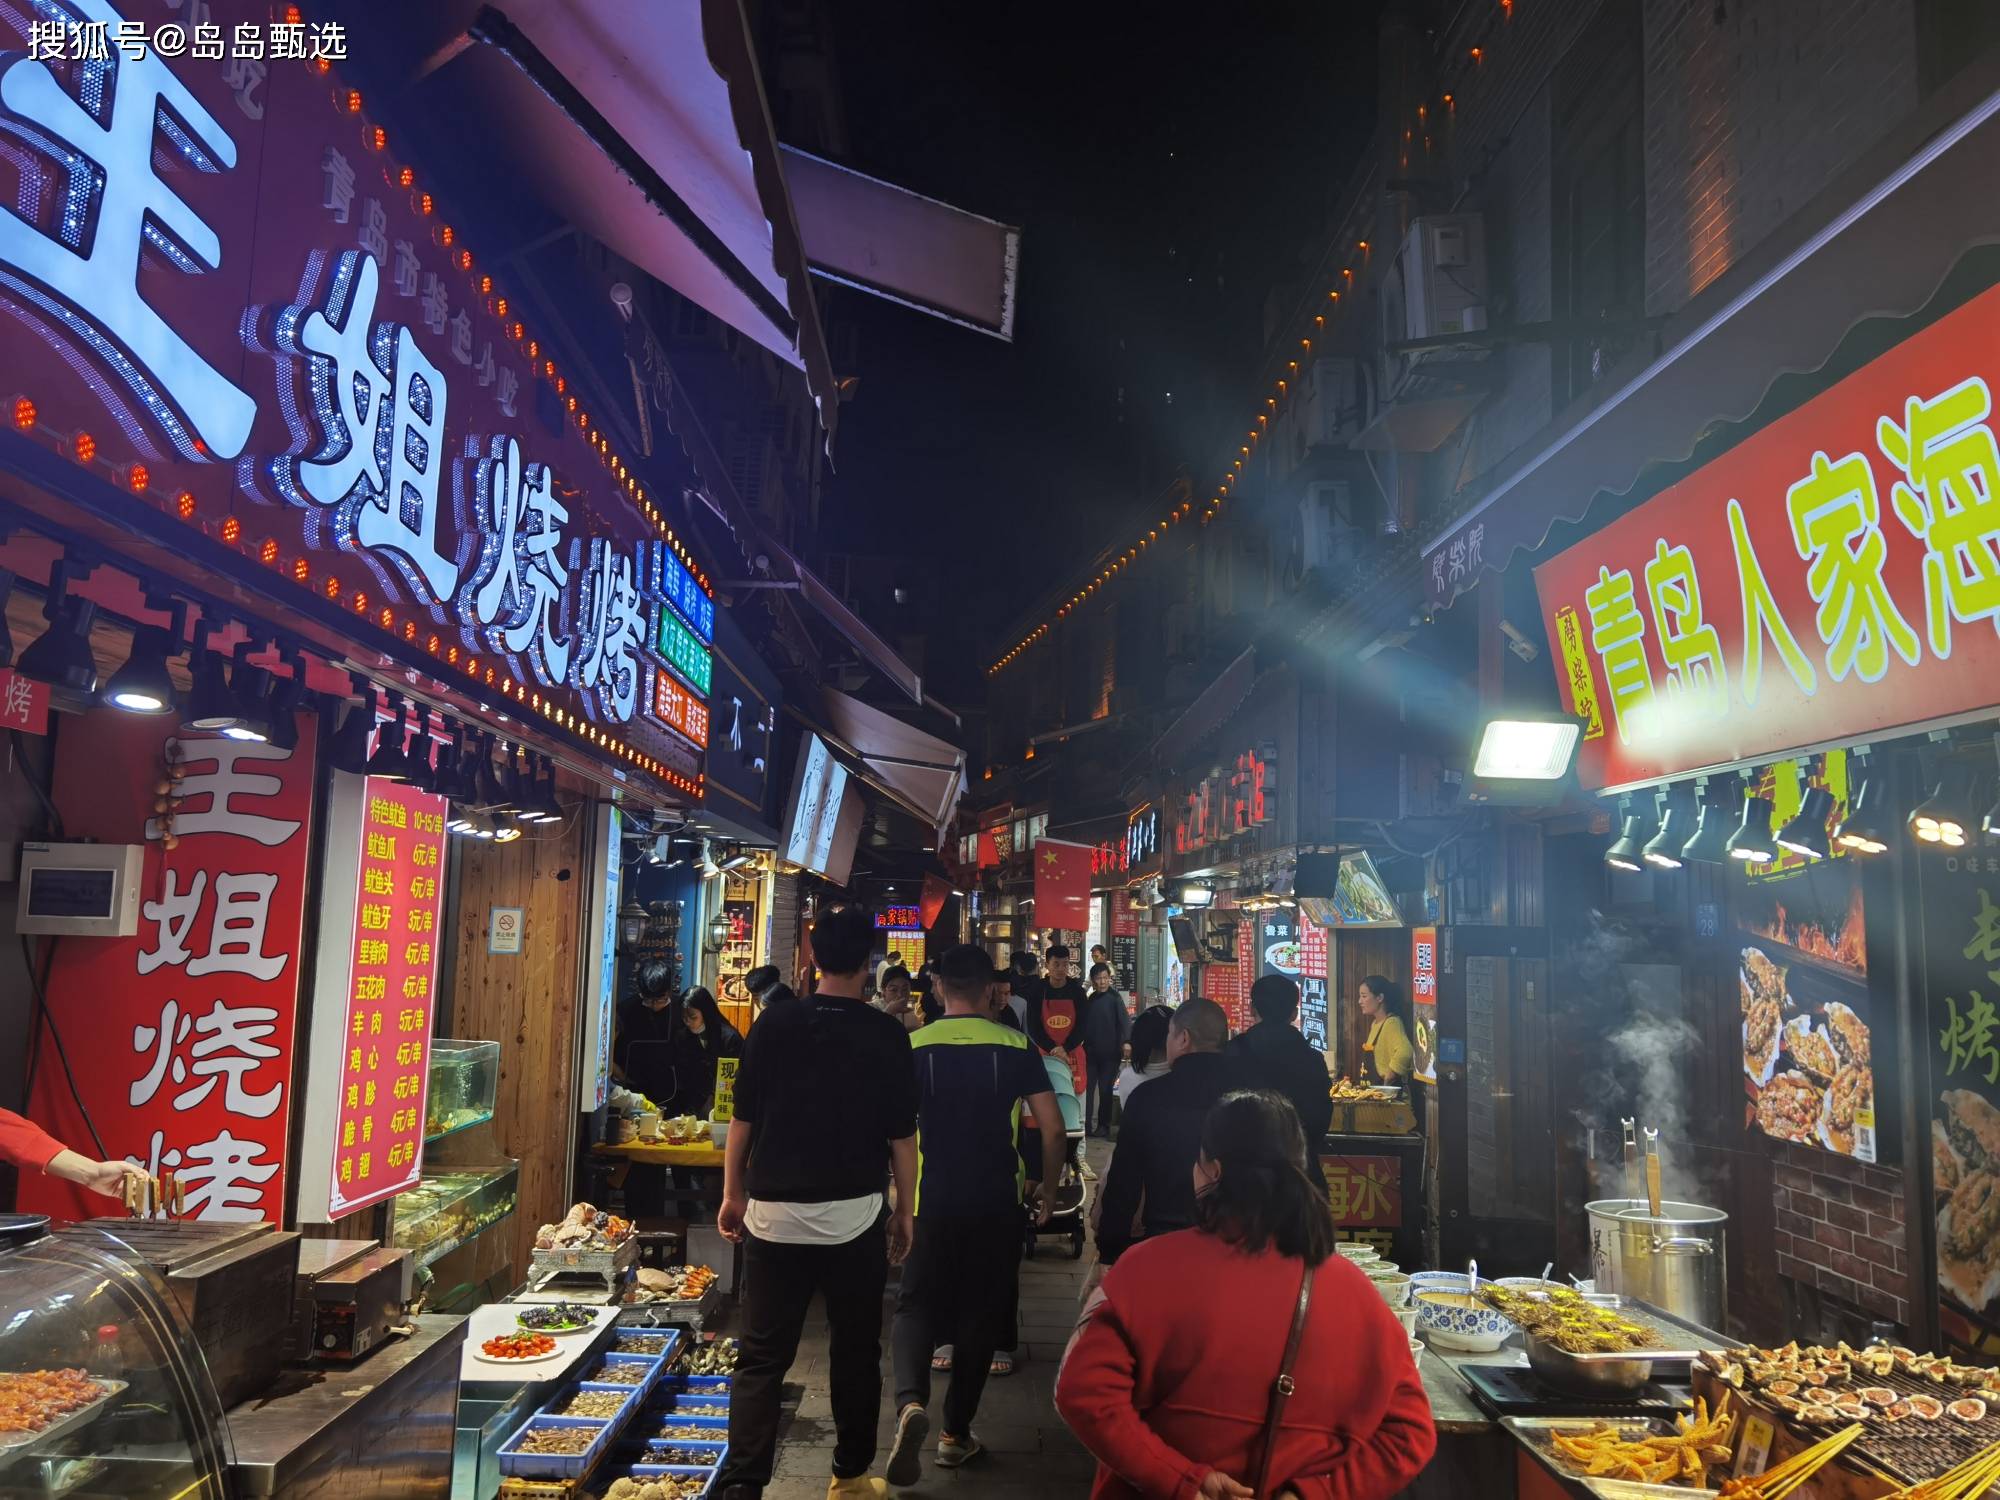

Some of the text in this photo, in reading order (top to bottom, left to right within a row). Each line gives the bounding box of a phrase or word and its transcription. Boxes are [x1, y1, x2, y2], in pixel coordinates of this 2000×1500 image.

[4, 674, 33, 725] 烤
[369, 796, 407, 830] 特色鱿鱼
[367, 831, 437, 868] 鱿鱼爪 6元/串
[364, 867, 435, 900] 鱿鱼头 4元/串
[361, 903, 433, 933] 鱿鱼牙 3元/串
[1700, 919, 1714, 937] 28
[405, 941, 430, 966] 4元/串
[126, 734, 302, 1222] 王姐烧烤
[355, 974, 428, 1000] 五花肉 4元/串
[352, 1007, 424, 1038] 羊肉 5元/串
[349, 1040, 422, 1073] 鸡心 4元/串
[393, 1073, 419, 1100] 4元/串
[343, 1105, 417, 1147] 脆骨 4元/串
[340, 1139, 414, 1183] 鸡翅 4元/串
